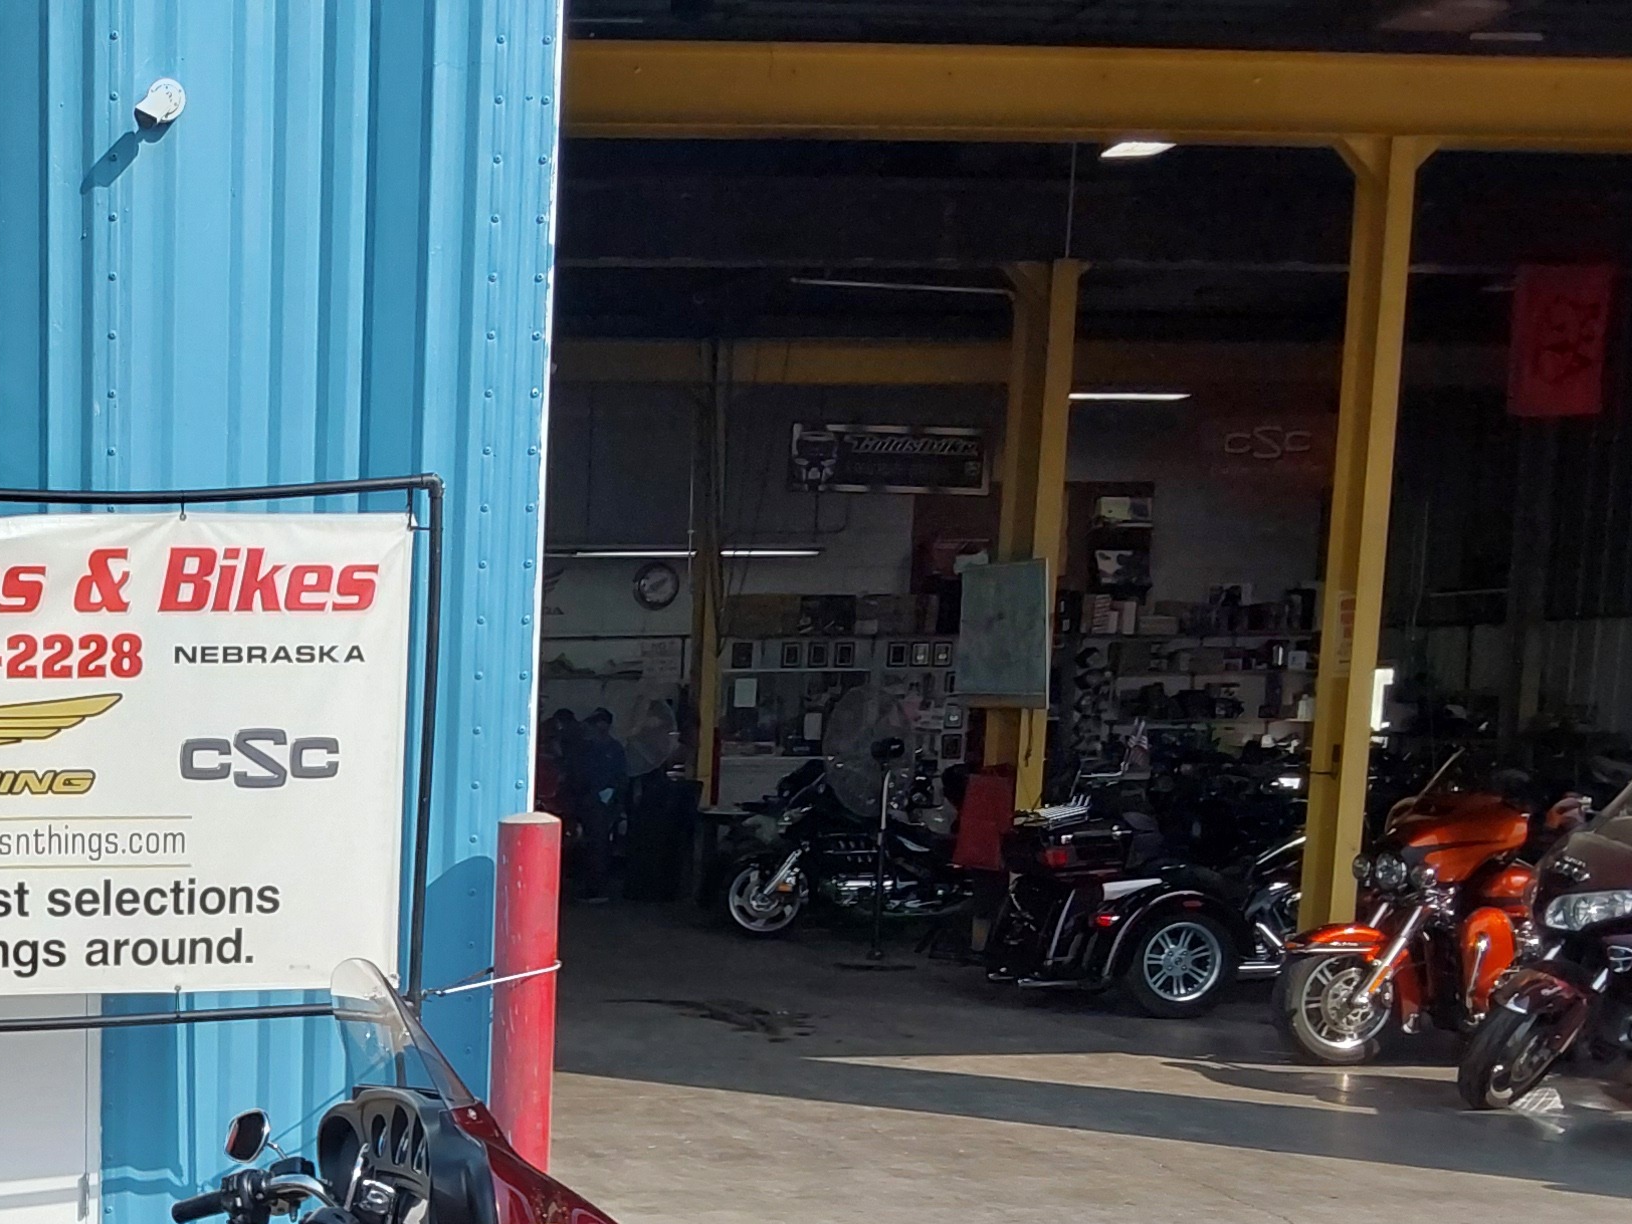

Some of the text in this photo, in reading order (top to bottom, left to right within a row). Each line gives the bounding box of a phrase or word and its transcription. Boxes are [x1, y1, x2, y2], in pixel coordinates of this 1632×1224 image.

[73, 548, 131, 613] &
[158, 547, 379, 612] Bikes
[174, 645, 365, 664] NEBRASKA
[47, 878, 281, 917] selections
[85, 928, 254, 966] around.
